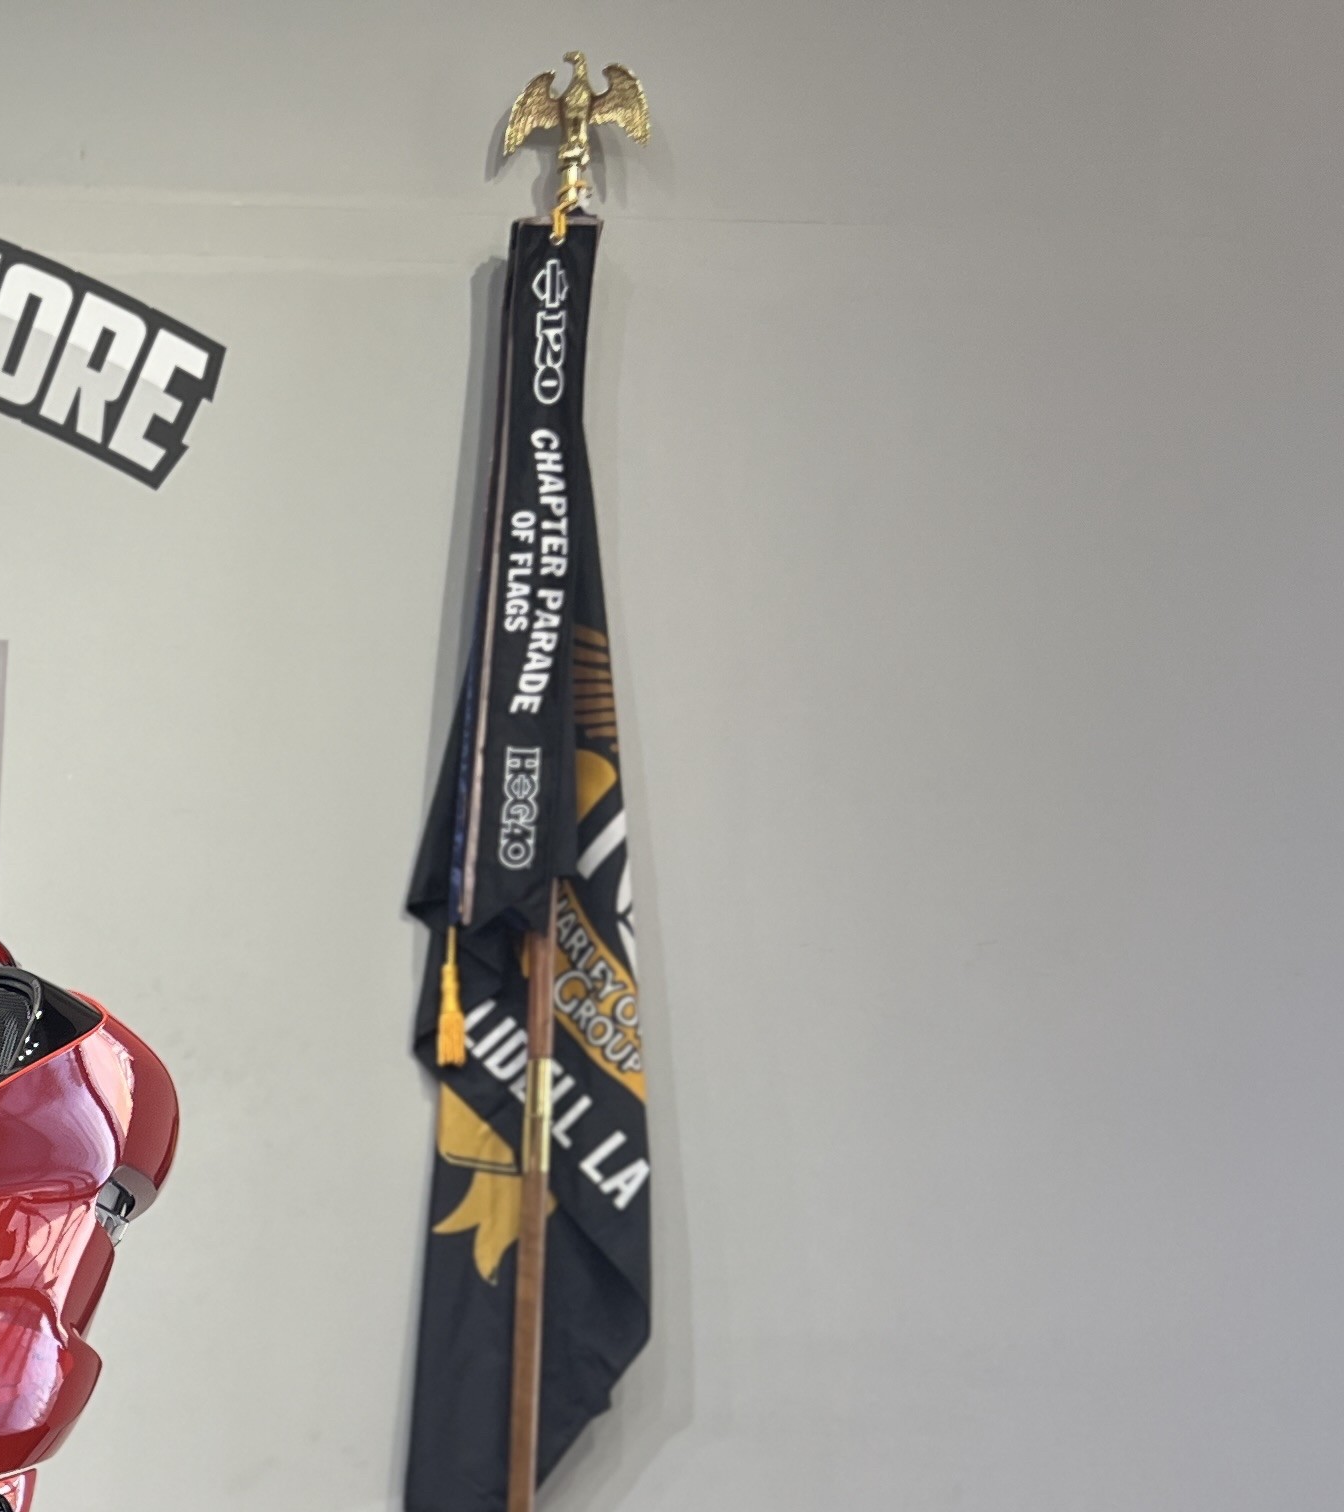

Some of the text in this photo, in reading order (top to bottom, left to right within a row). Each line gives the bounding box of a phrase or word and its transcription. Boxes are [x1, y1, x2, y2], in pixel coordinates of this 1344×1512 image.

[504, 510, 537, 633] OF FLAGS
[509, 428, 569, 715] CHAPTER PARADE
[553, 969, 642, 1073] GROUP
[579, 1130, 650, 1211] LA
